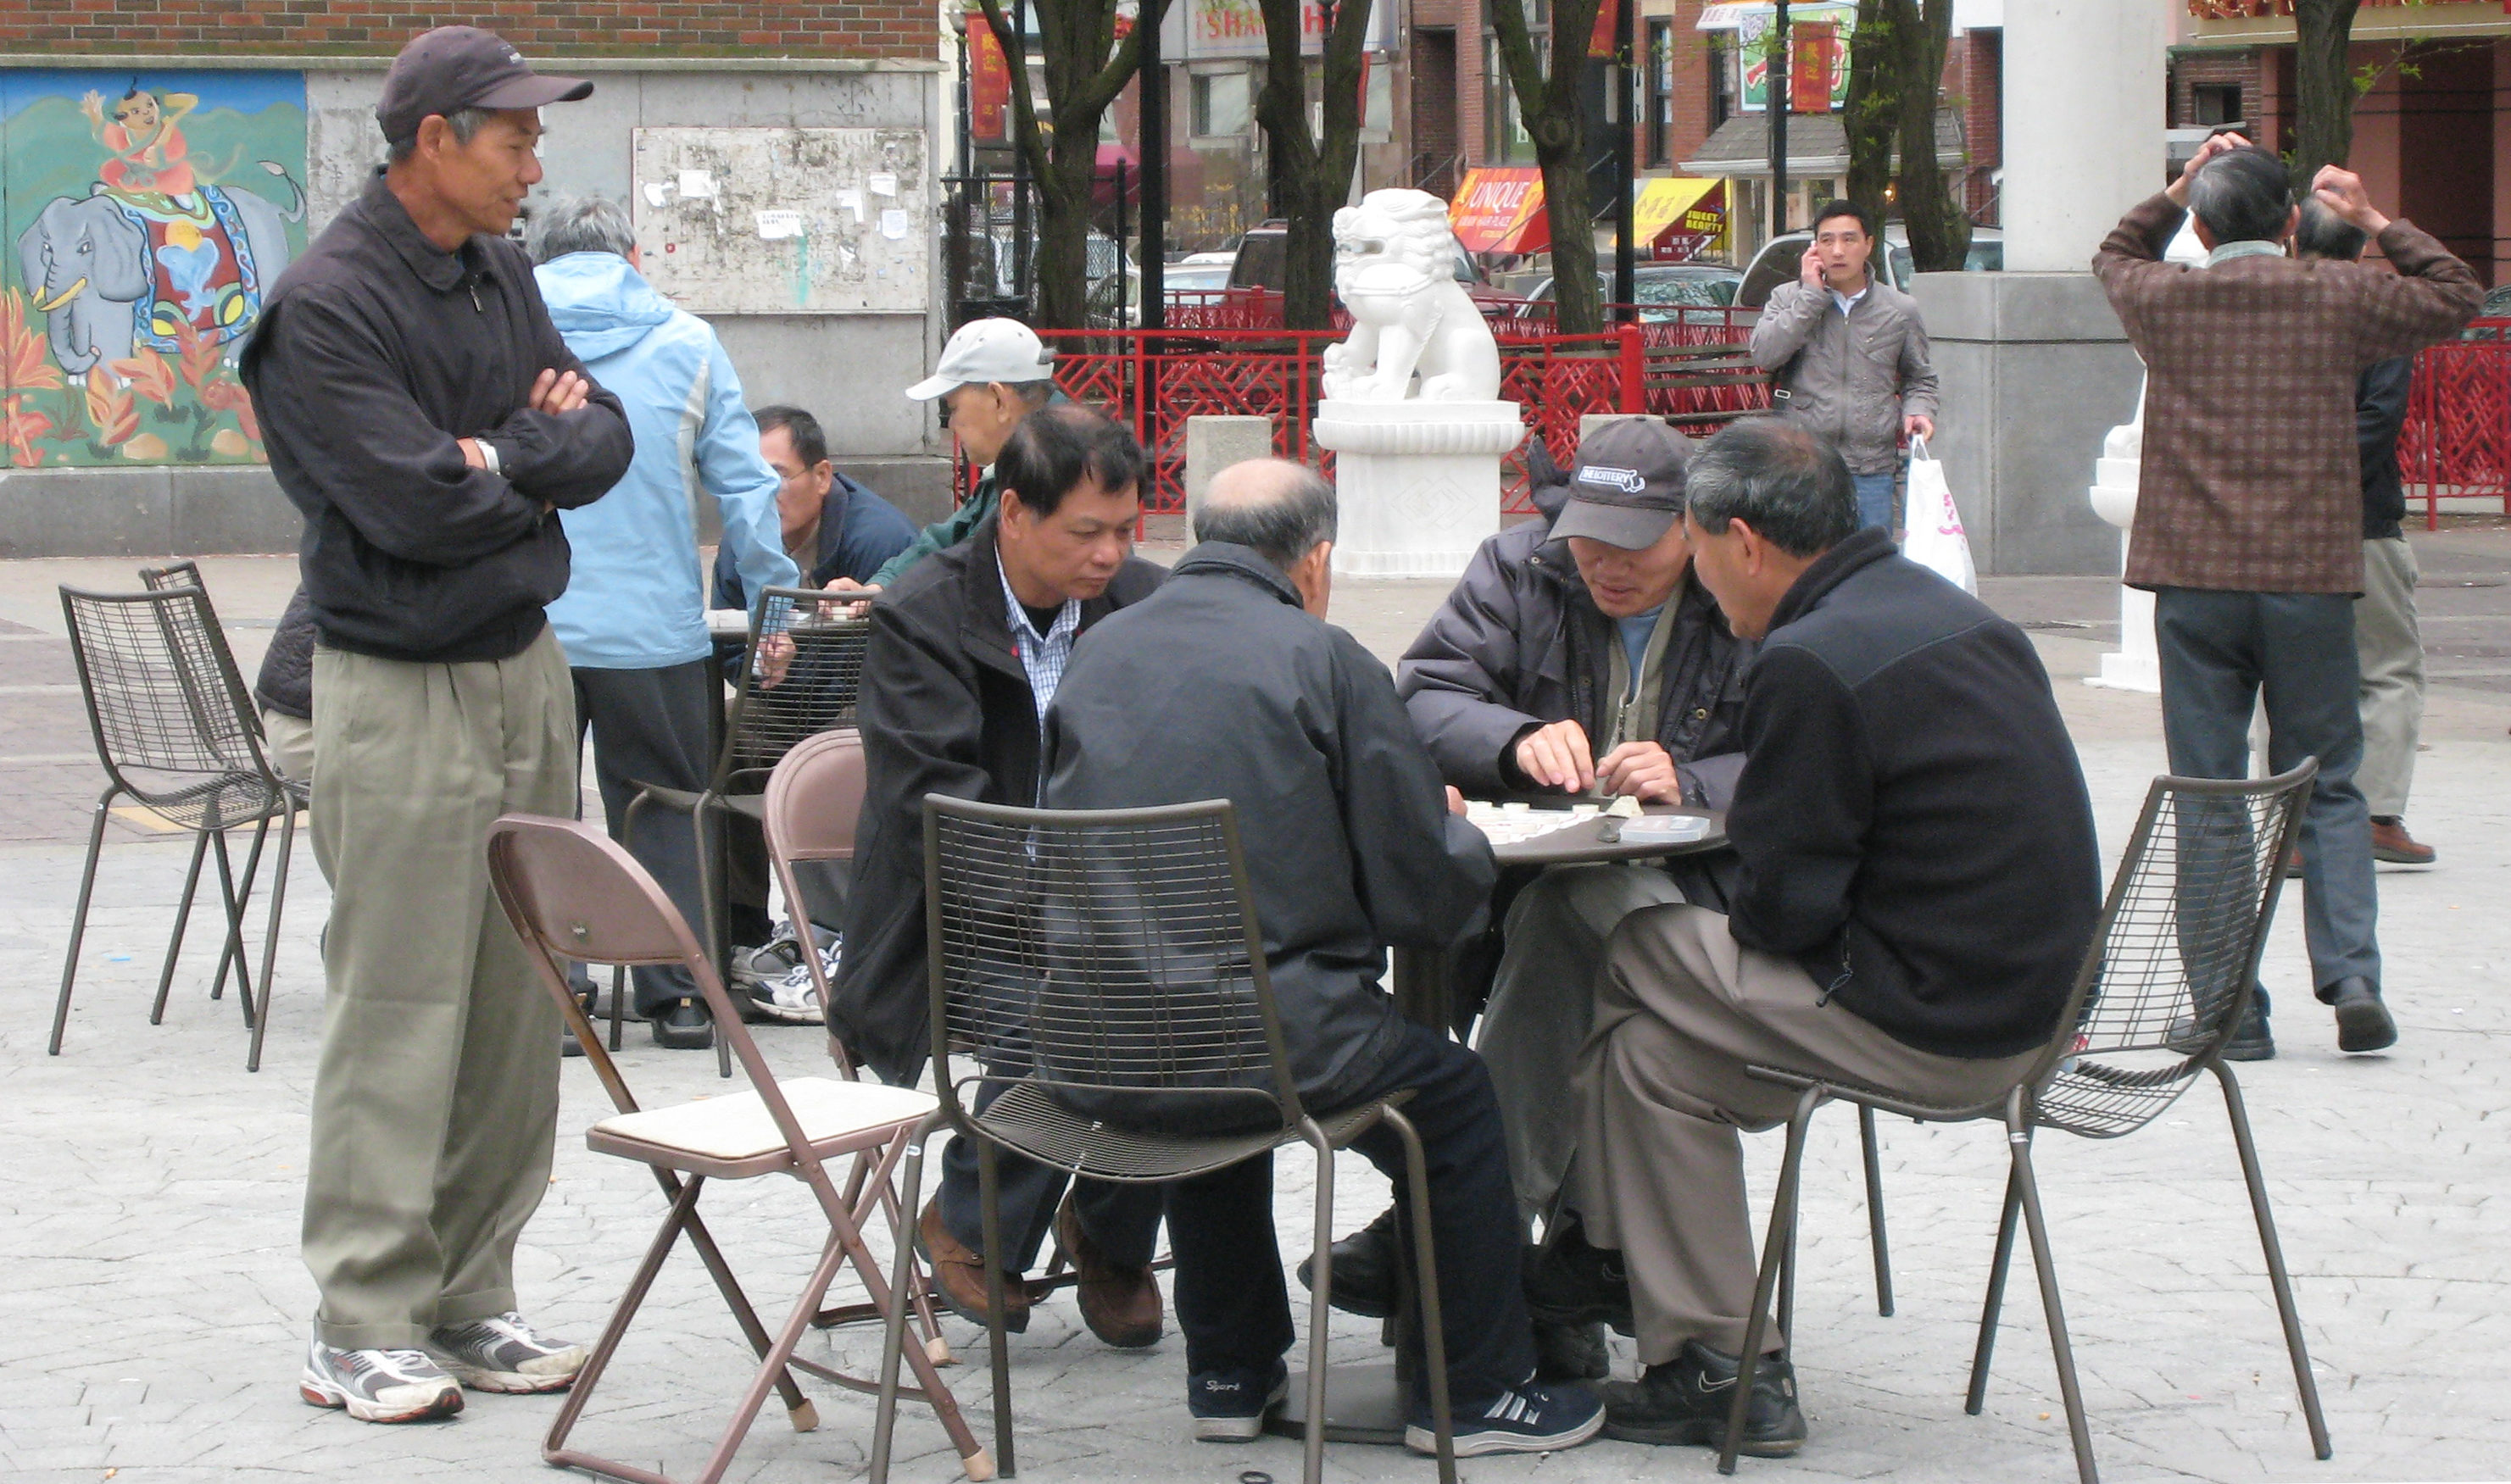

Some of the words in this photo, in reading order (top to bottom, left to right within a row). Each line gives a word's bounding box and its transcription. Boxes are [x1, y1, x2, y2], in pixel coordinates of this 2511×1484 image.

[1468, 181, 1530, 213] UNIQUE
[1686, 209, 1719, 221] SWEET
[1685, 219, 1723, 232] BEAUTY
[1594, 470, 1631, 484] LOTTERY
[1205, 1380, 1241, 1392] Sport
